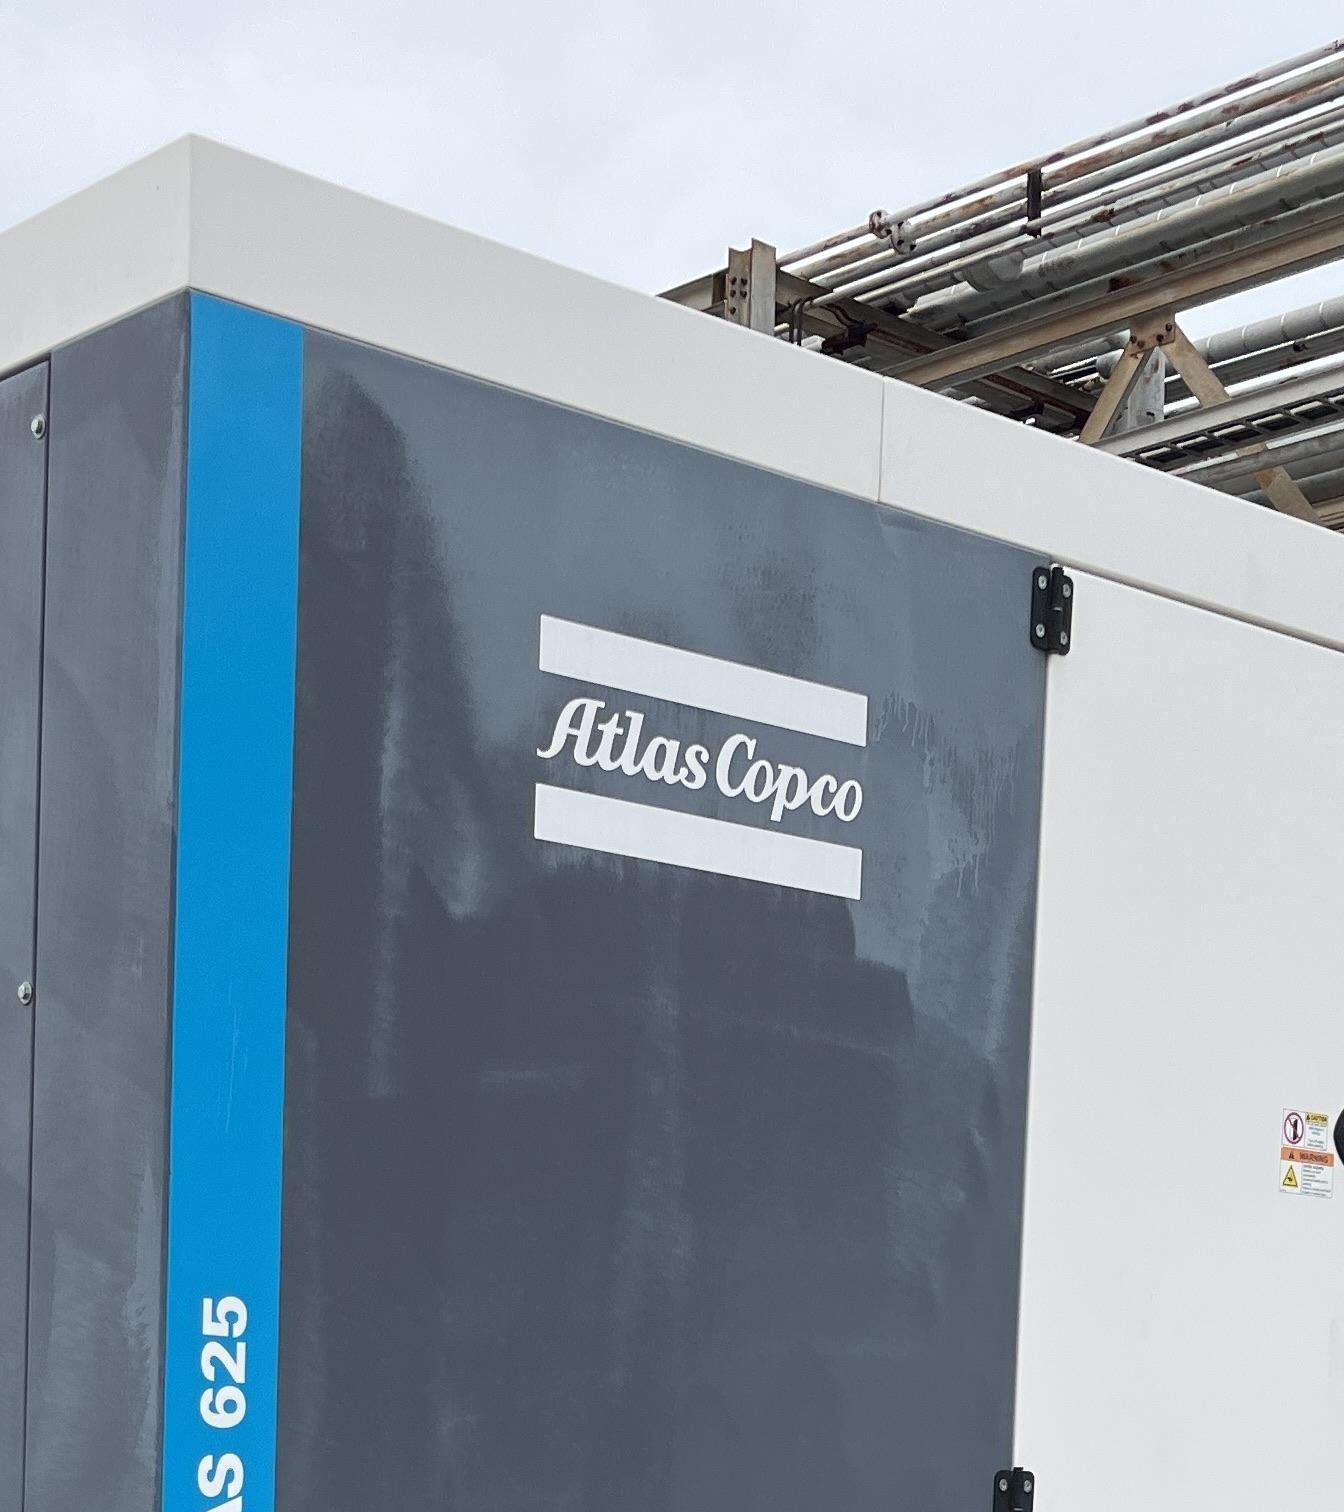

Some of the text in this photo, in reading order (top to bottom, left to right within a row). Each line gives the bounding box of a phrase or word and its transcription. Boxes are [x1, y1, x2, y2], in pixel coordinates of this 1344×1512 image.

[536, 698, 863, 822] Atlas Copco
[199, 1296, 248, 1429] 625
